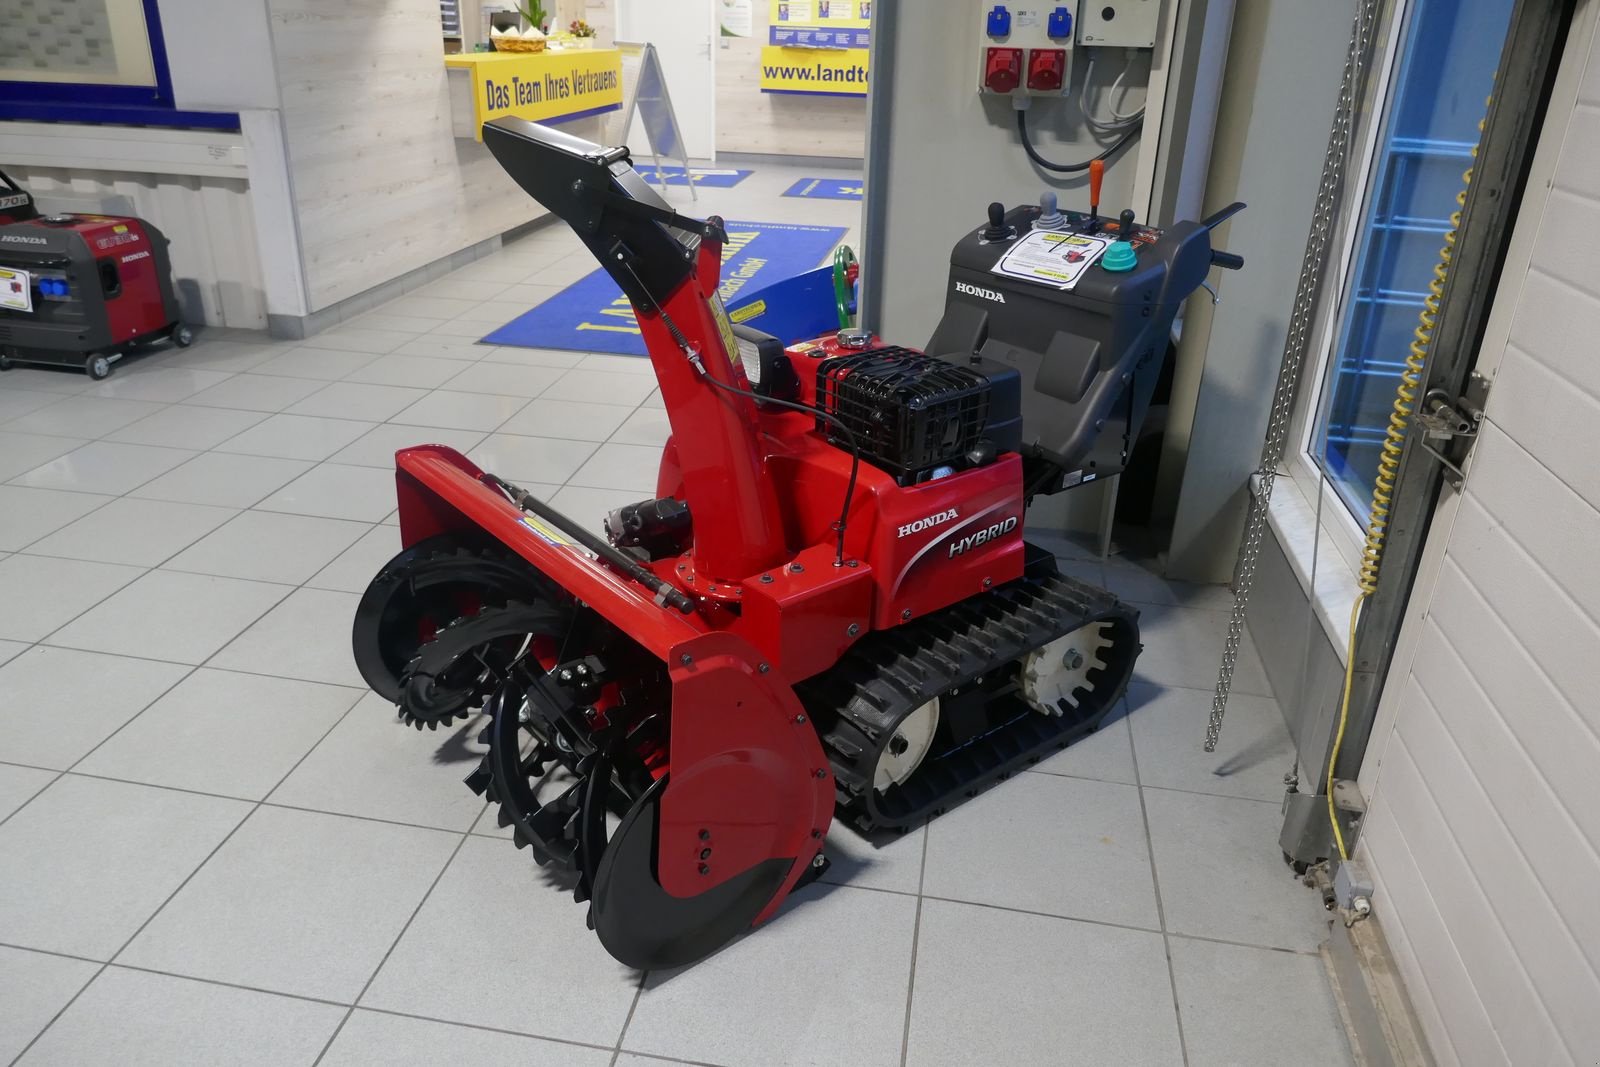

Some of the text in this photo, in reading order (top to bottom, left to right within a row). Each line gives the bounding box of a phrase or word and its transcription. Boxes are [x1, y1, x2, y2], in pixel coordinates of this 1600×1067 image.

[763, 63, 869, 83] www.landt
[486, 69, 618, 111] Das Team Ihres Vertrauens
[1, 235, 48, 245] HONDA
[121, 251, 149, 263] HONDA
[955, 281, 1006, 304] HONDA
[897, 508, 959, 538] HONDA
[948, 516, 1018, 559] HYBRID
